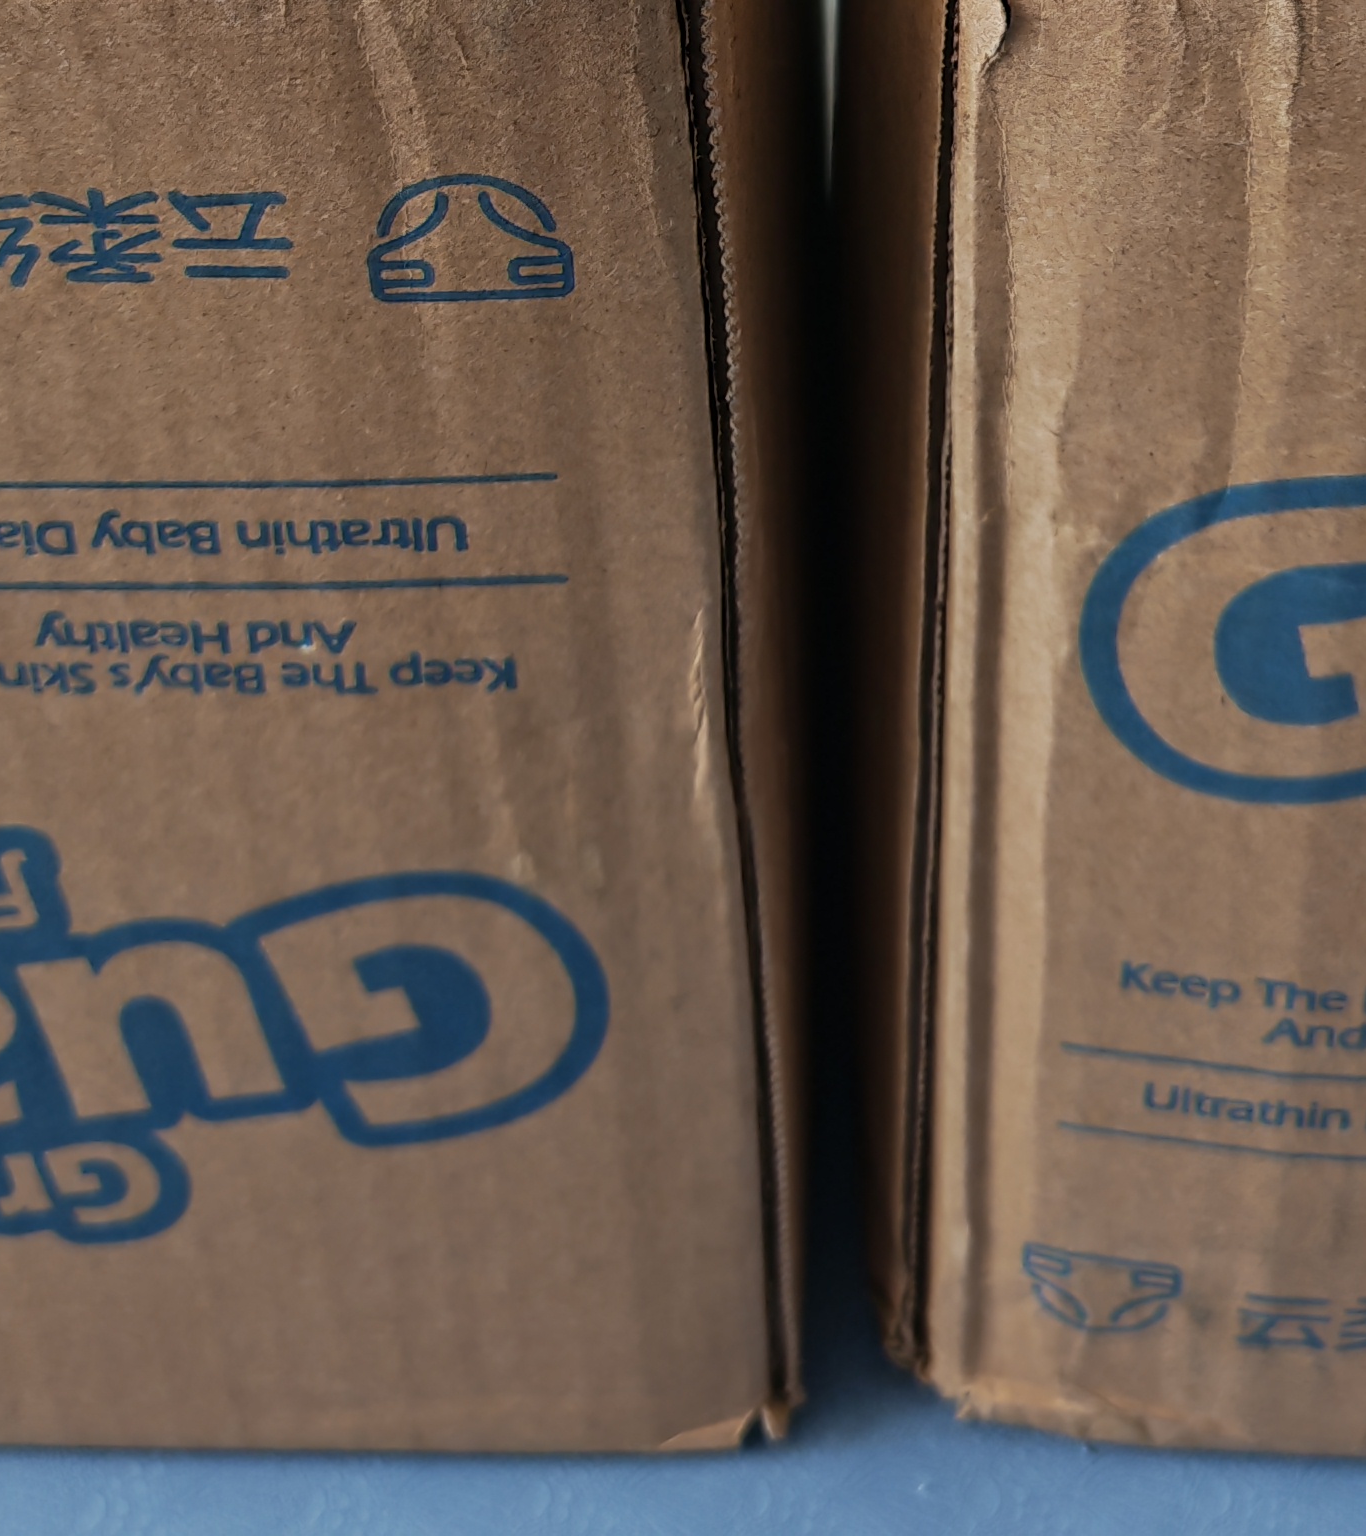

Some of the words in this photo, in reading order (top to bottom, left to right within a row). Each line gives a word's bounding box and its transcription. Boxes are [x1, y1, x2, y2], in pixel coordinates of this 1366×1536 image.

[91, 510, 221, 557] Baby
[236, 516, 468, 556] Ultrathin
[35, 612, 231, 654] Healthy
[246, 621, 356, 654] And
[107, 653, 266, 696] Baby's
[281, 662, 378, 696] The
[388, 652, 518, 693] Keep
[1120, 960, 1242, 1009] Keep
[1258, 978, 1350, 1015] The
[1142, 1081, 1352, 1133] Ultrathin
